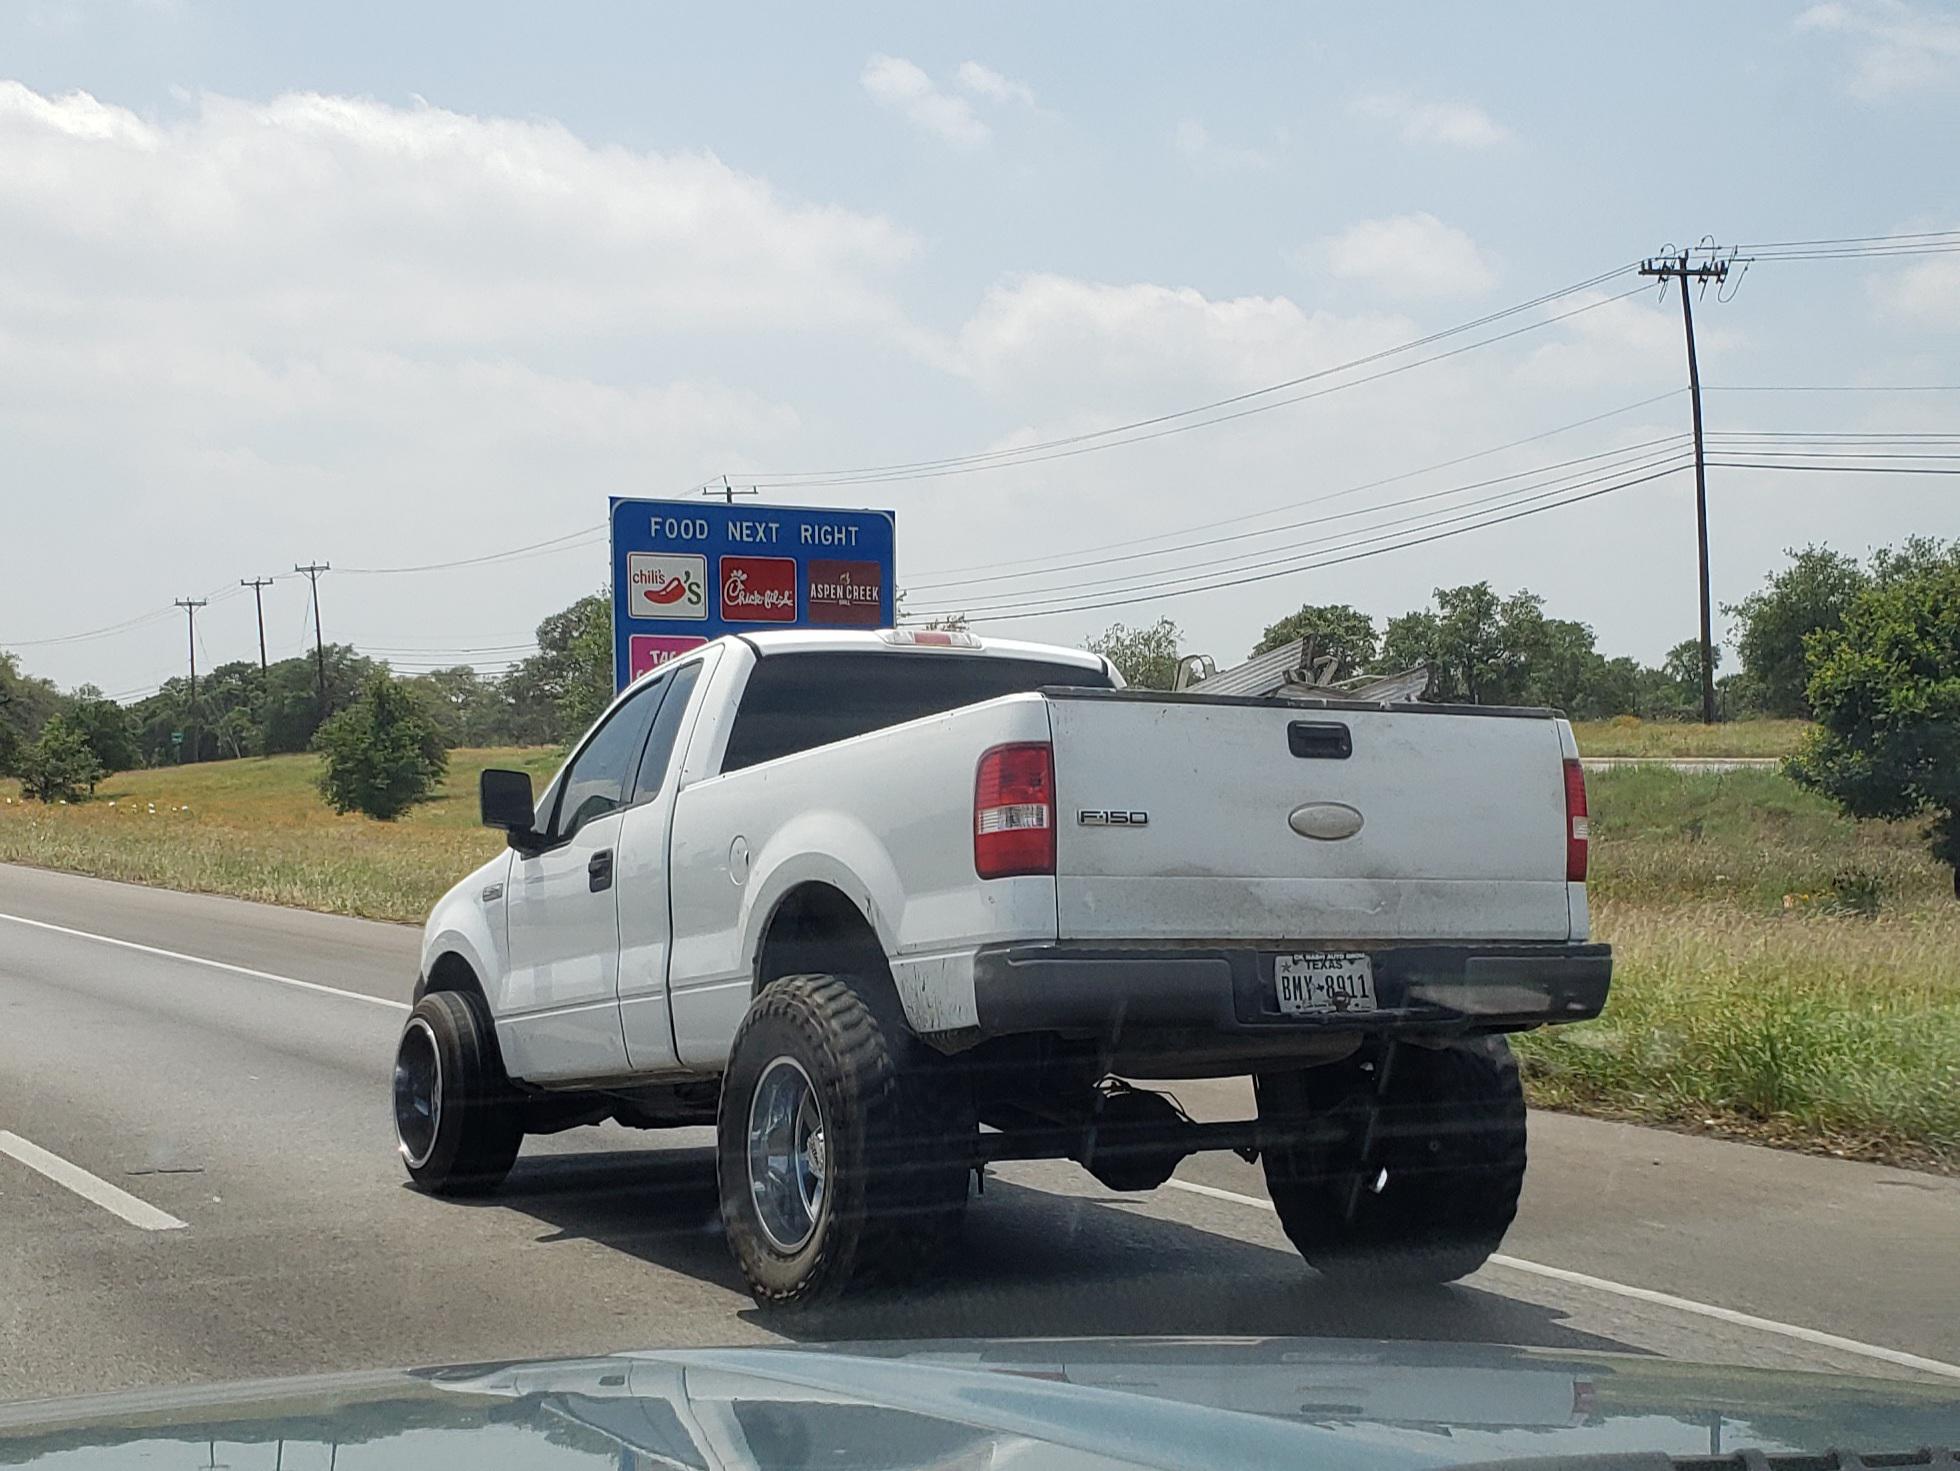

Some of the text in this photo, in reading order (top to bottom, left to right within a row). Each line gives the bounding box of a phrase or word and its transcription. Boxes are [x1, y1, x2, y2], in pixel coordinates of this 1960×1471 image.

[650, 517, 859, 546] FOOD NEXT RIGHT
[810, 583, 879, 601] ASPEN CREEK
[1306, 960, 1342, 970] TEXAS
